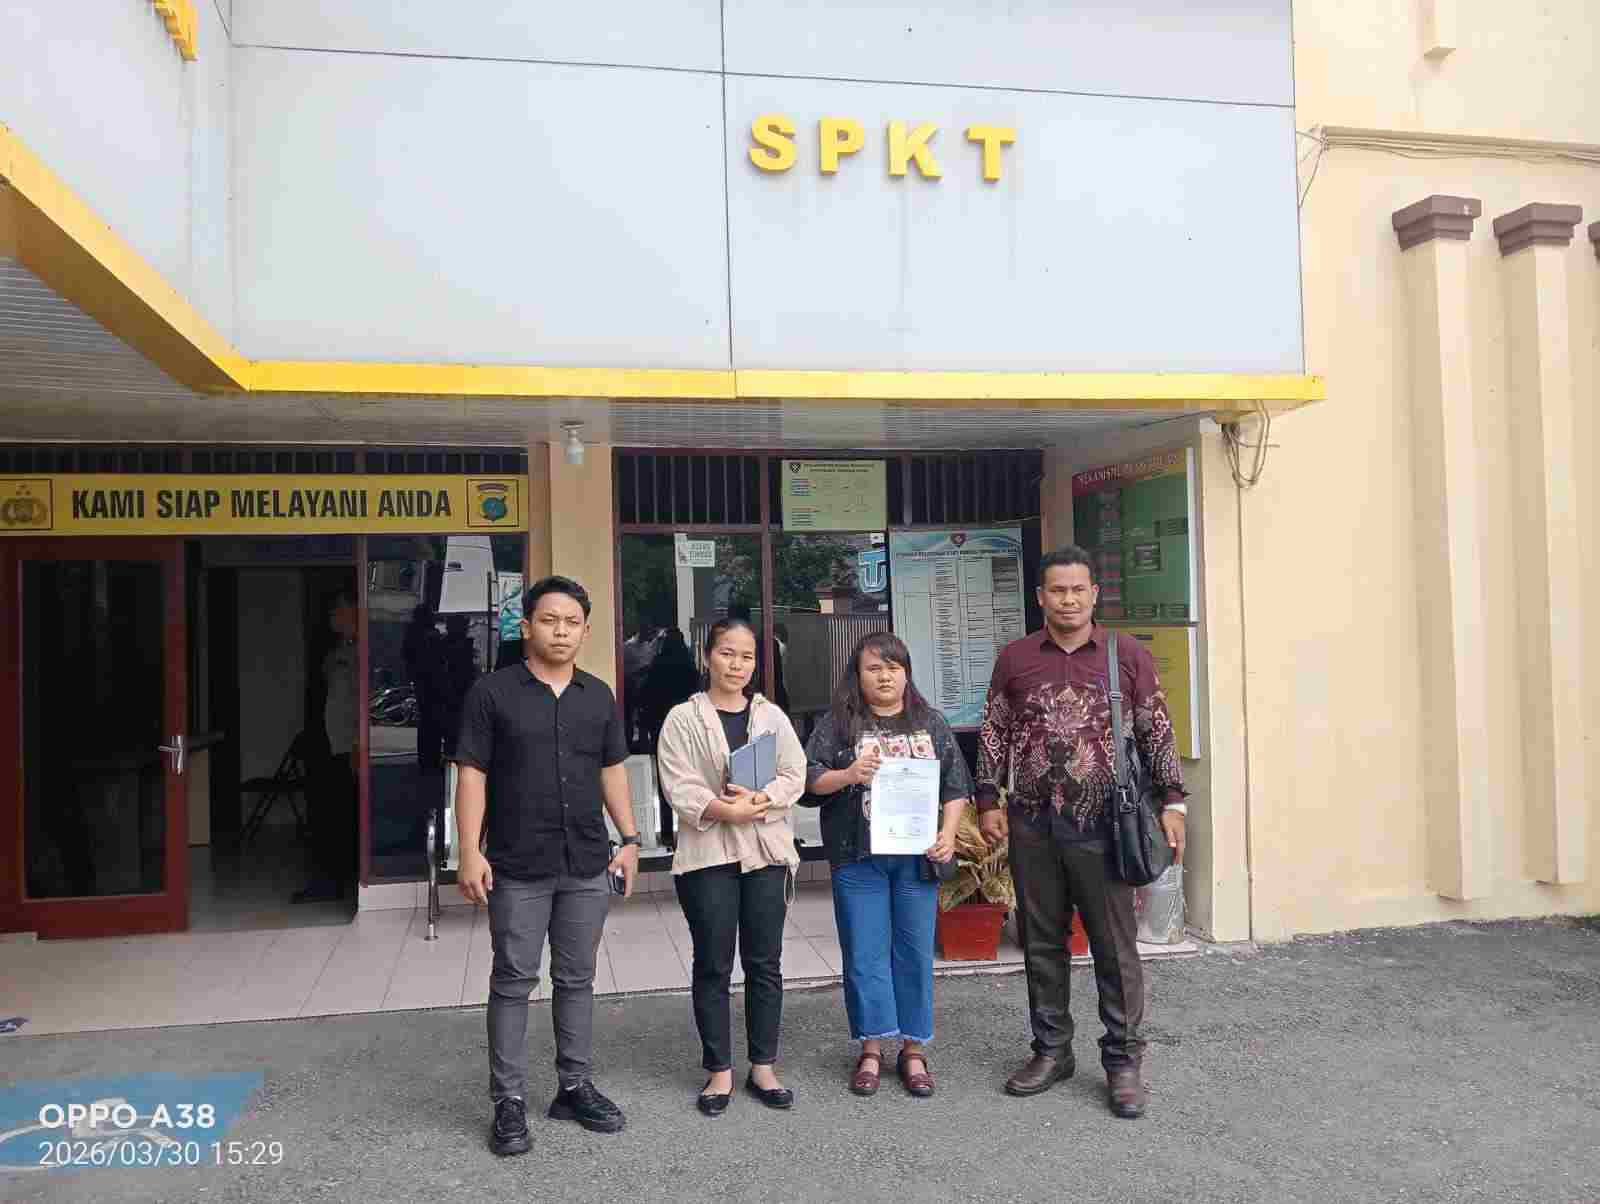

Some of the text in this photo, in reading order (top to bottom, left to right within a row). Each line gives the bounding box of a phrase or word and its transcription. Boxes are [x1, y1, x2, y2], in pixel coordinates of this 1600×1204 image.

[748, 113, 1017, 183] SPKT
[72, 489, 452, 519] KAMI SIAP MELAYANI ANDA
